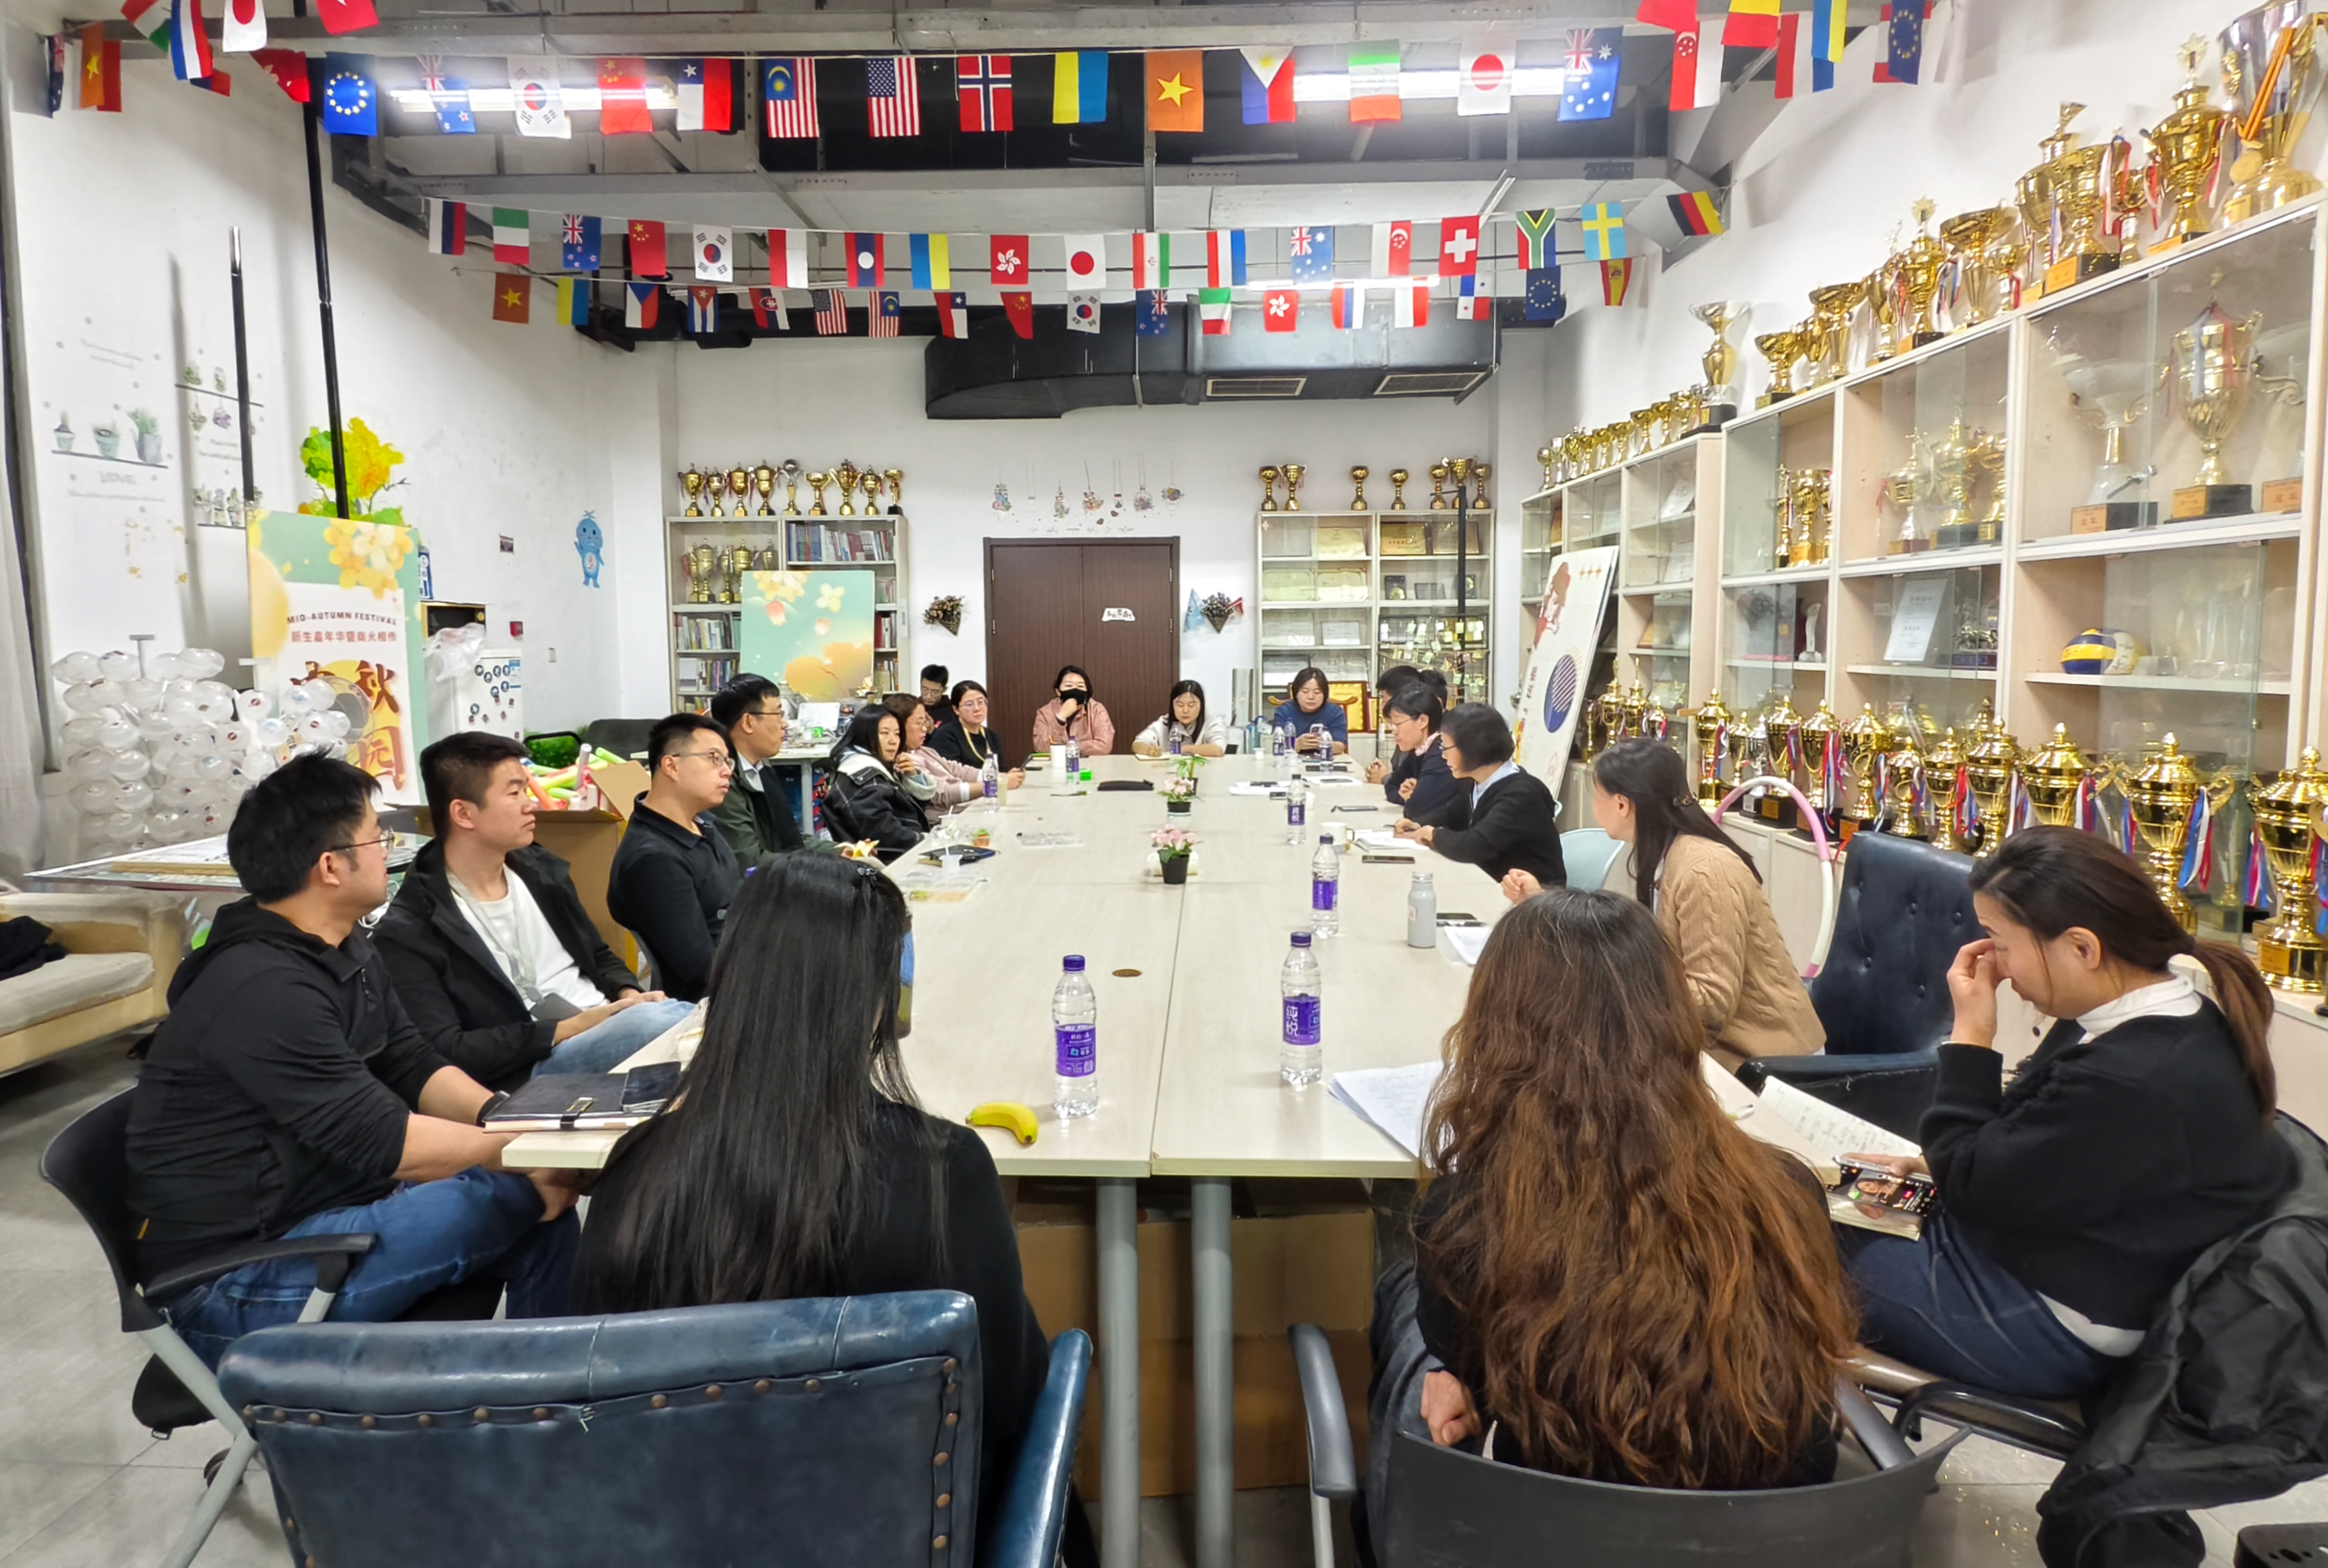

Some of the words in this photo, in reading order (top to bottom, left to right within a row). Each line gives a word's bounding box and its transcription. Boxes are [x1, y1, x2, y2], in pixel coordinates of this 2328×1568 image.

[287, 612, 352, 624] MID-AUTUMN
[355, 612, 397, 626] FESTIVAL
[1286, 1005, 1299, 1037] 纯悦
